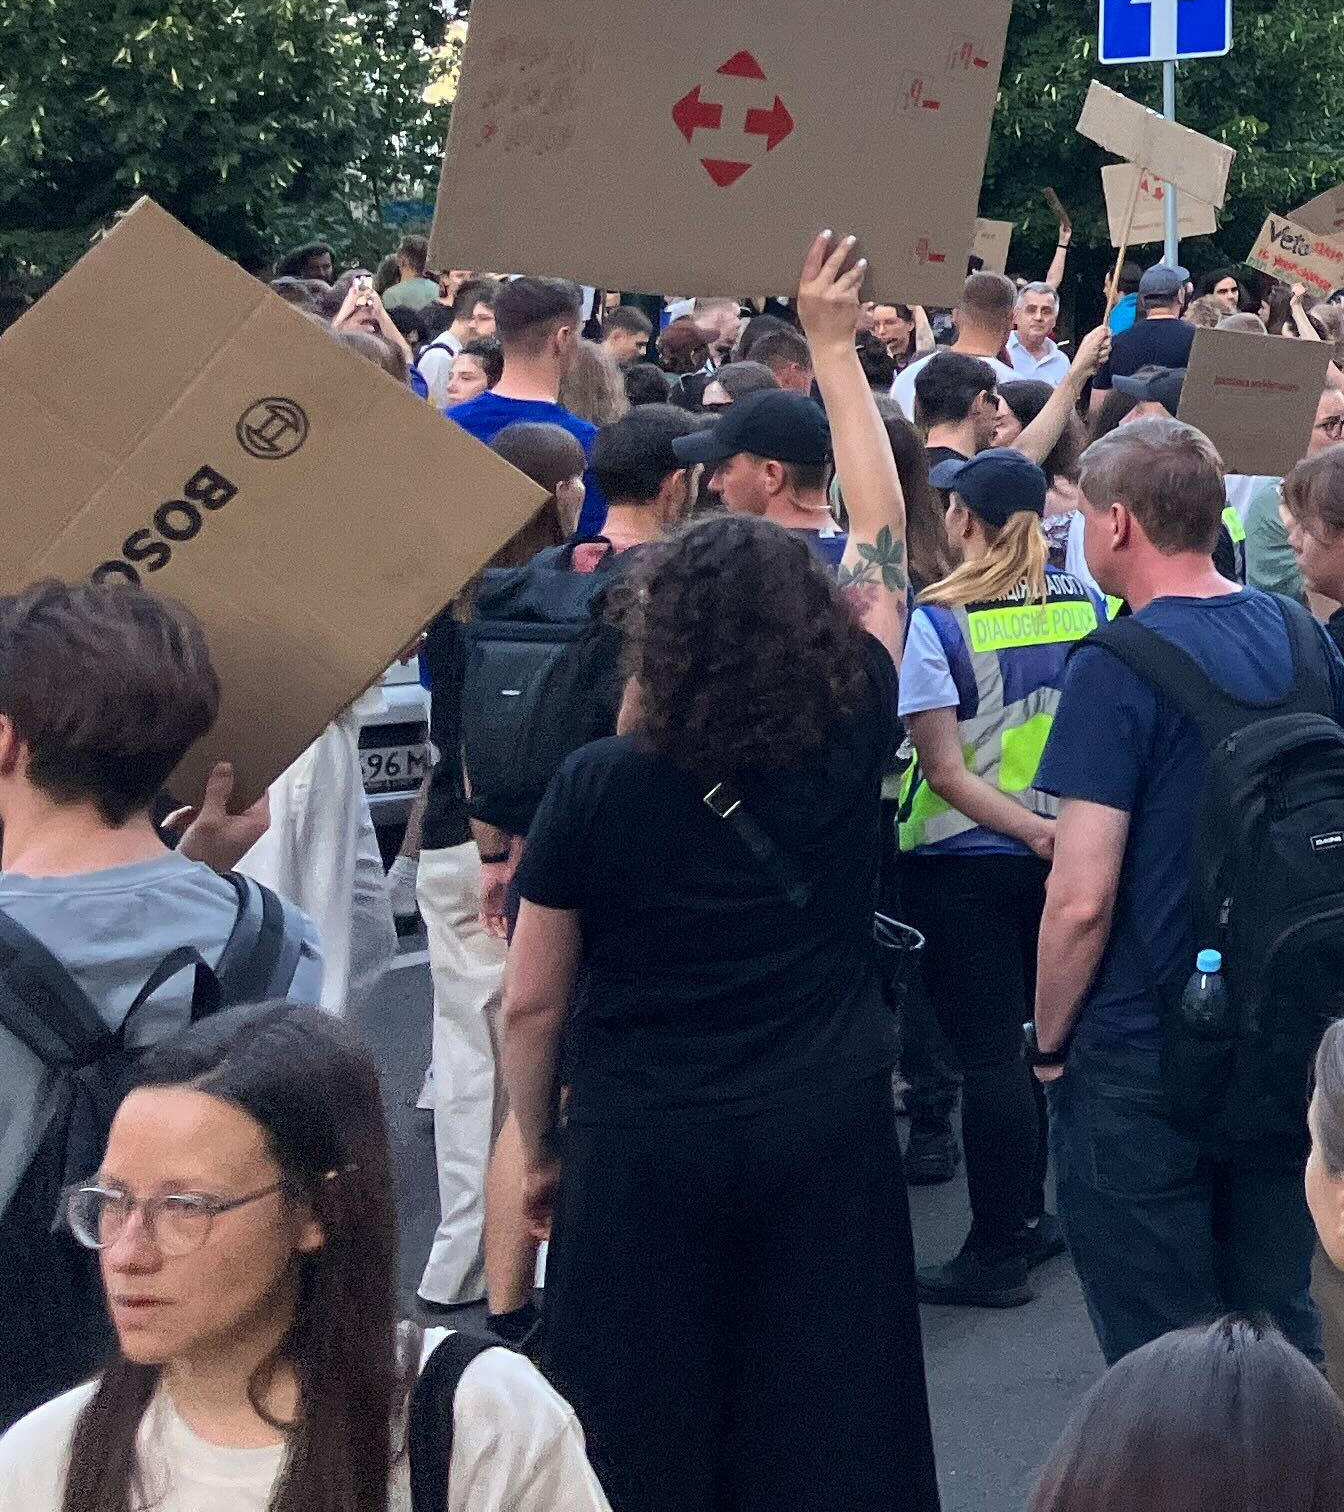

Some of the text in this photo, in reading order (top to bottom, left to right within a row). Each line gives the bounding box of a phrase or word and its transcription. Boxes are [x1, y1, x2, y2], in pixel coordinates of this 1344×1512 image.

[91, 464, 239, 589] BOSC
[974, 608, 1094, 644] DIALOGUE POLIC
[361, 752, 400, 779] 96
